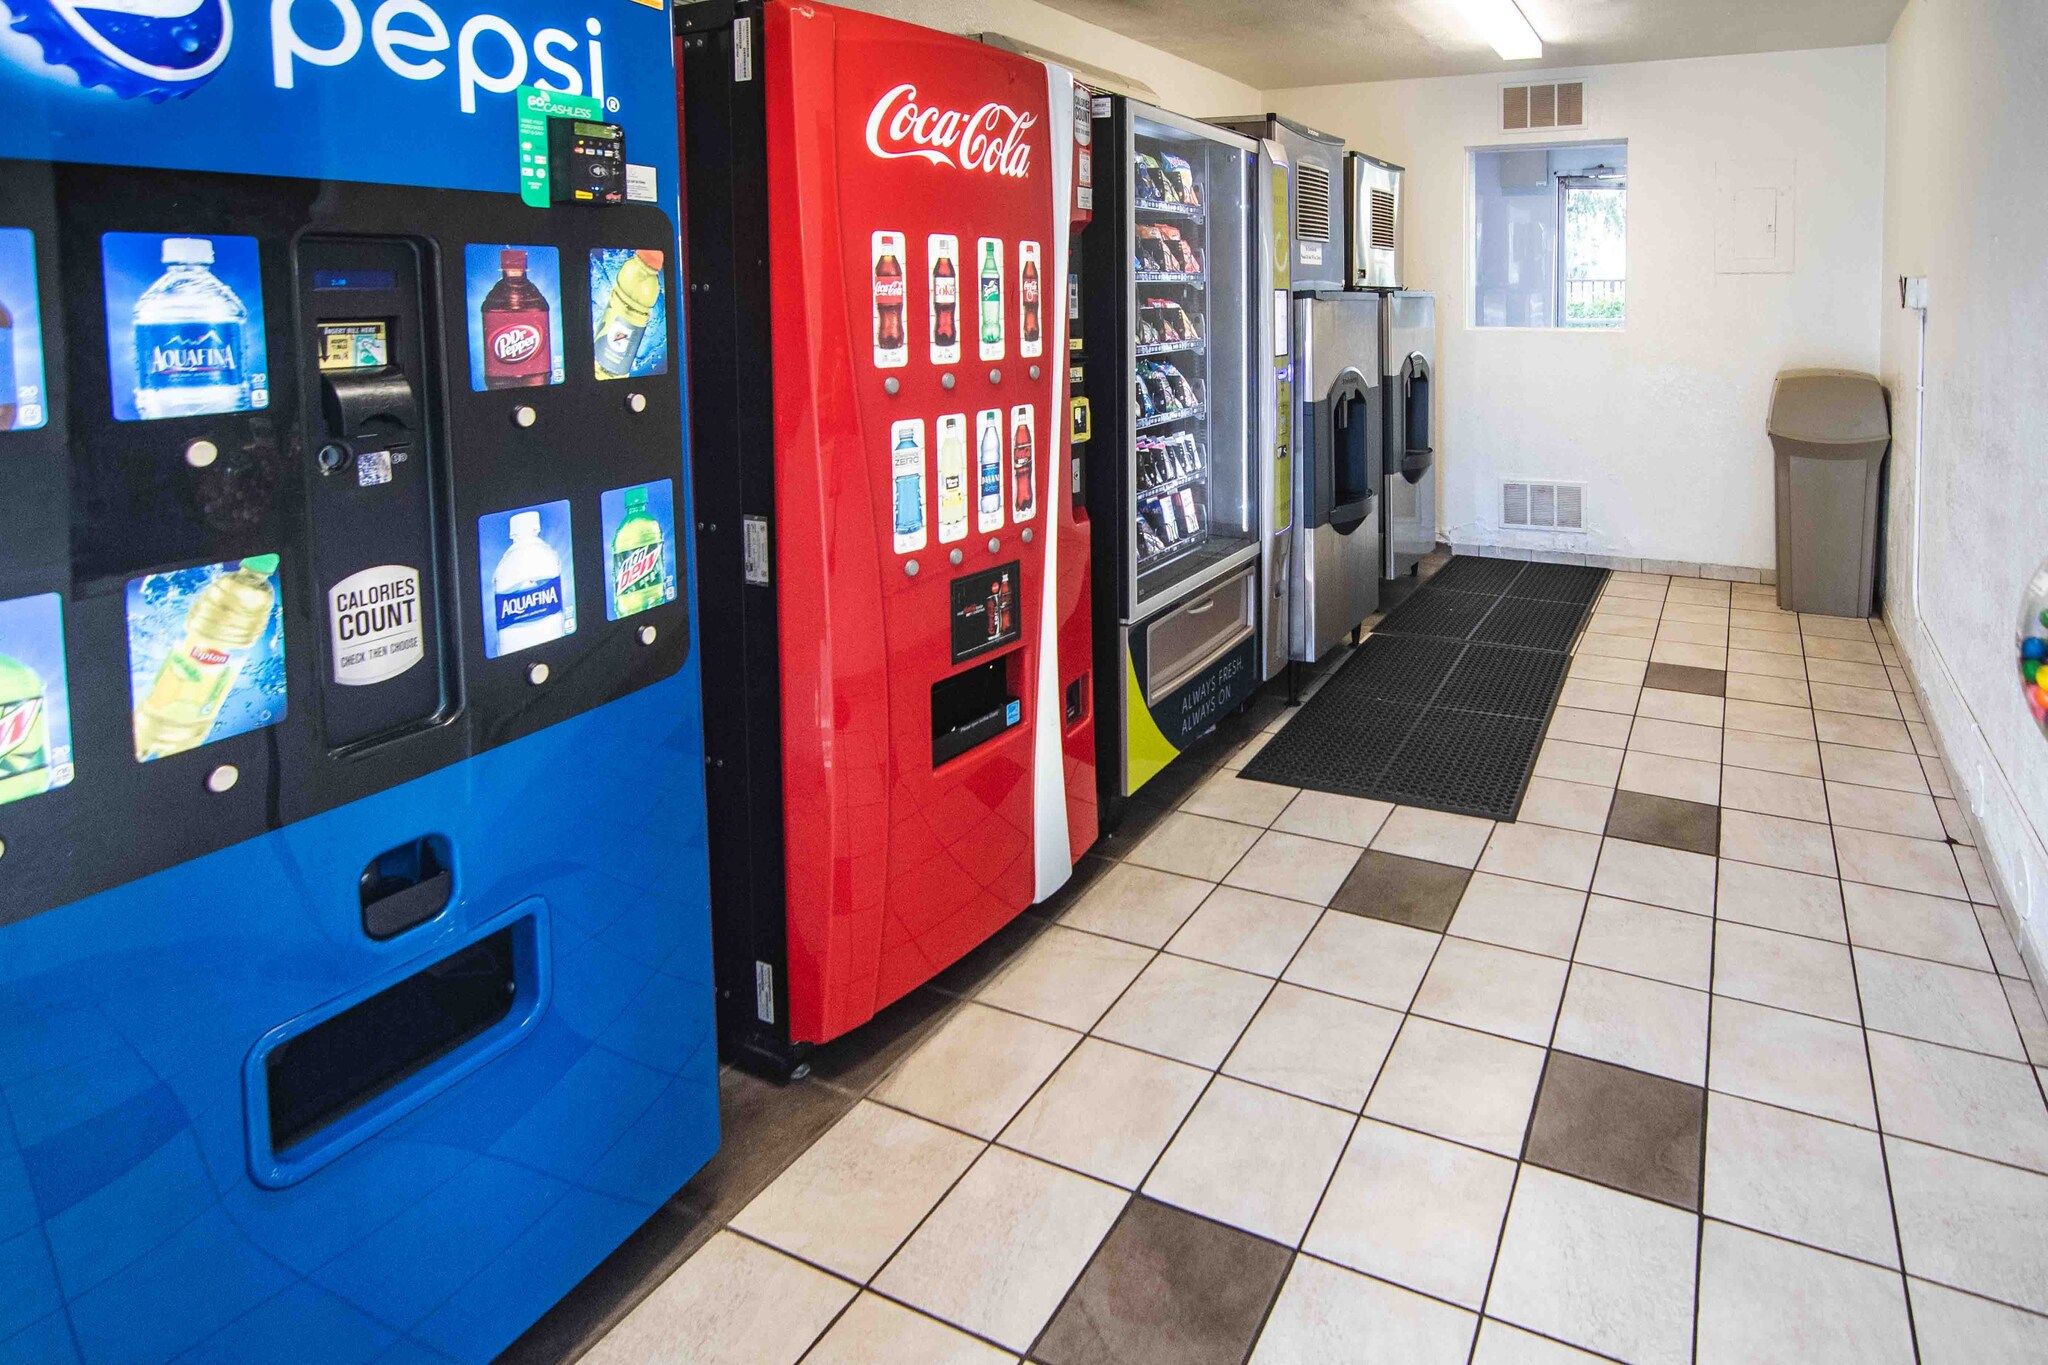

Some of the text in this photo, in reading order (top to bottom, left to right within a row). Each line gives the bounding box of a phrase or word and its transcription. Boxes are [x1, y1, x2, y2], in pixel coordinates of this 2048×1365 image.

[270, 0, 605, 114] pepsi
[527, 95, 592, 119] GO CASHLESS
[865, 83, 1038, 179] Coca-Cola
[151, 345, 236, 374] AQUAFINA
[494, 333, 537, 359] Pepper
[337, 578, 415, 612] CALORIES
[501, 586, 558, 619] AQUAFINA
[339, 598, 416, 640] COUNT
[192, 649, 226, 663] Lipton
[340, 637, 419, 668] CHECK THEN CHOOSE
[1181, 675, 1216, 714] ALWAYS
[1181, 683, 1231, 736] ALWAYS ON
